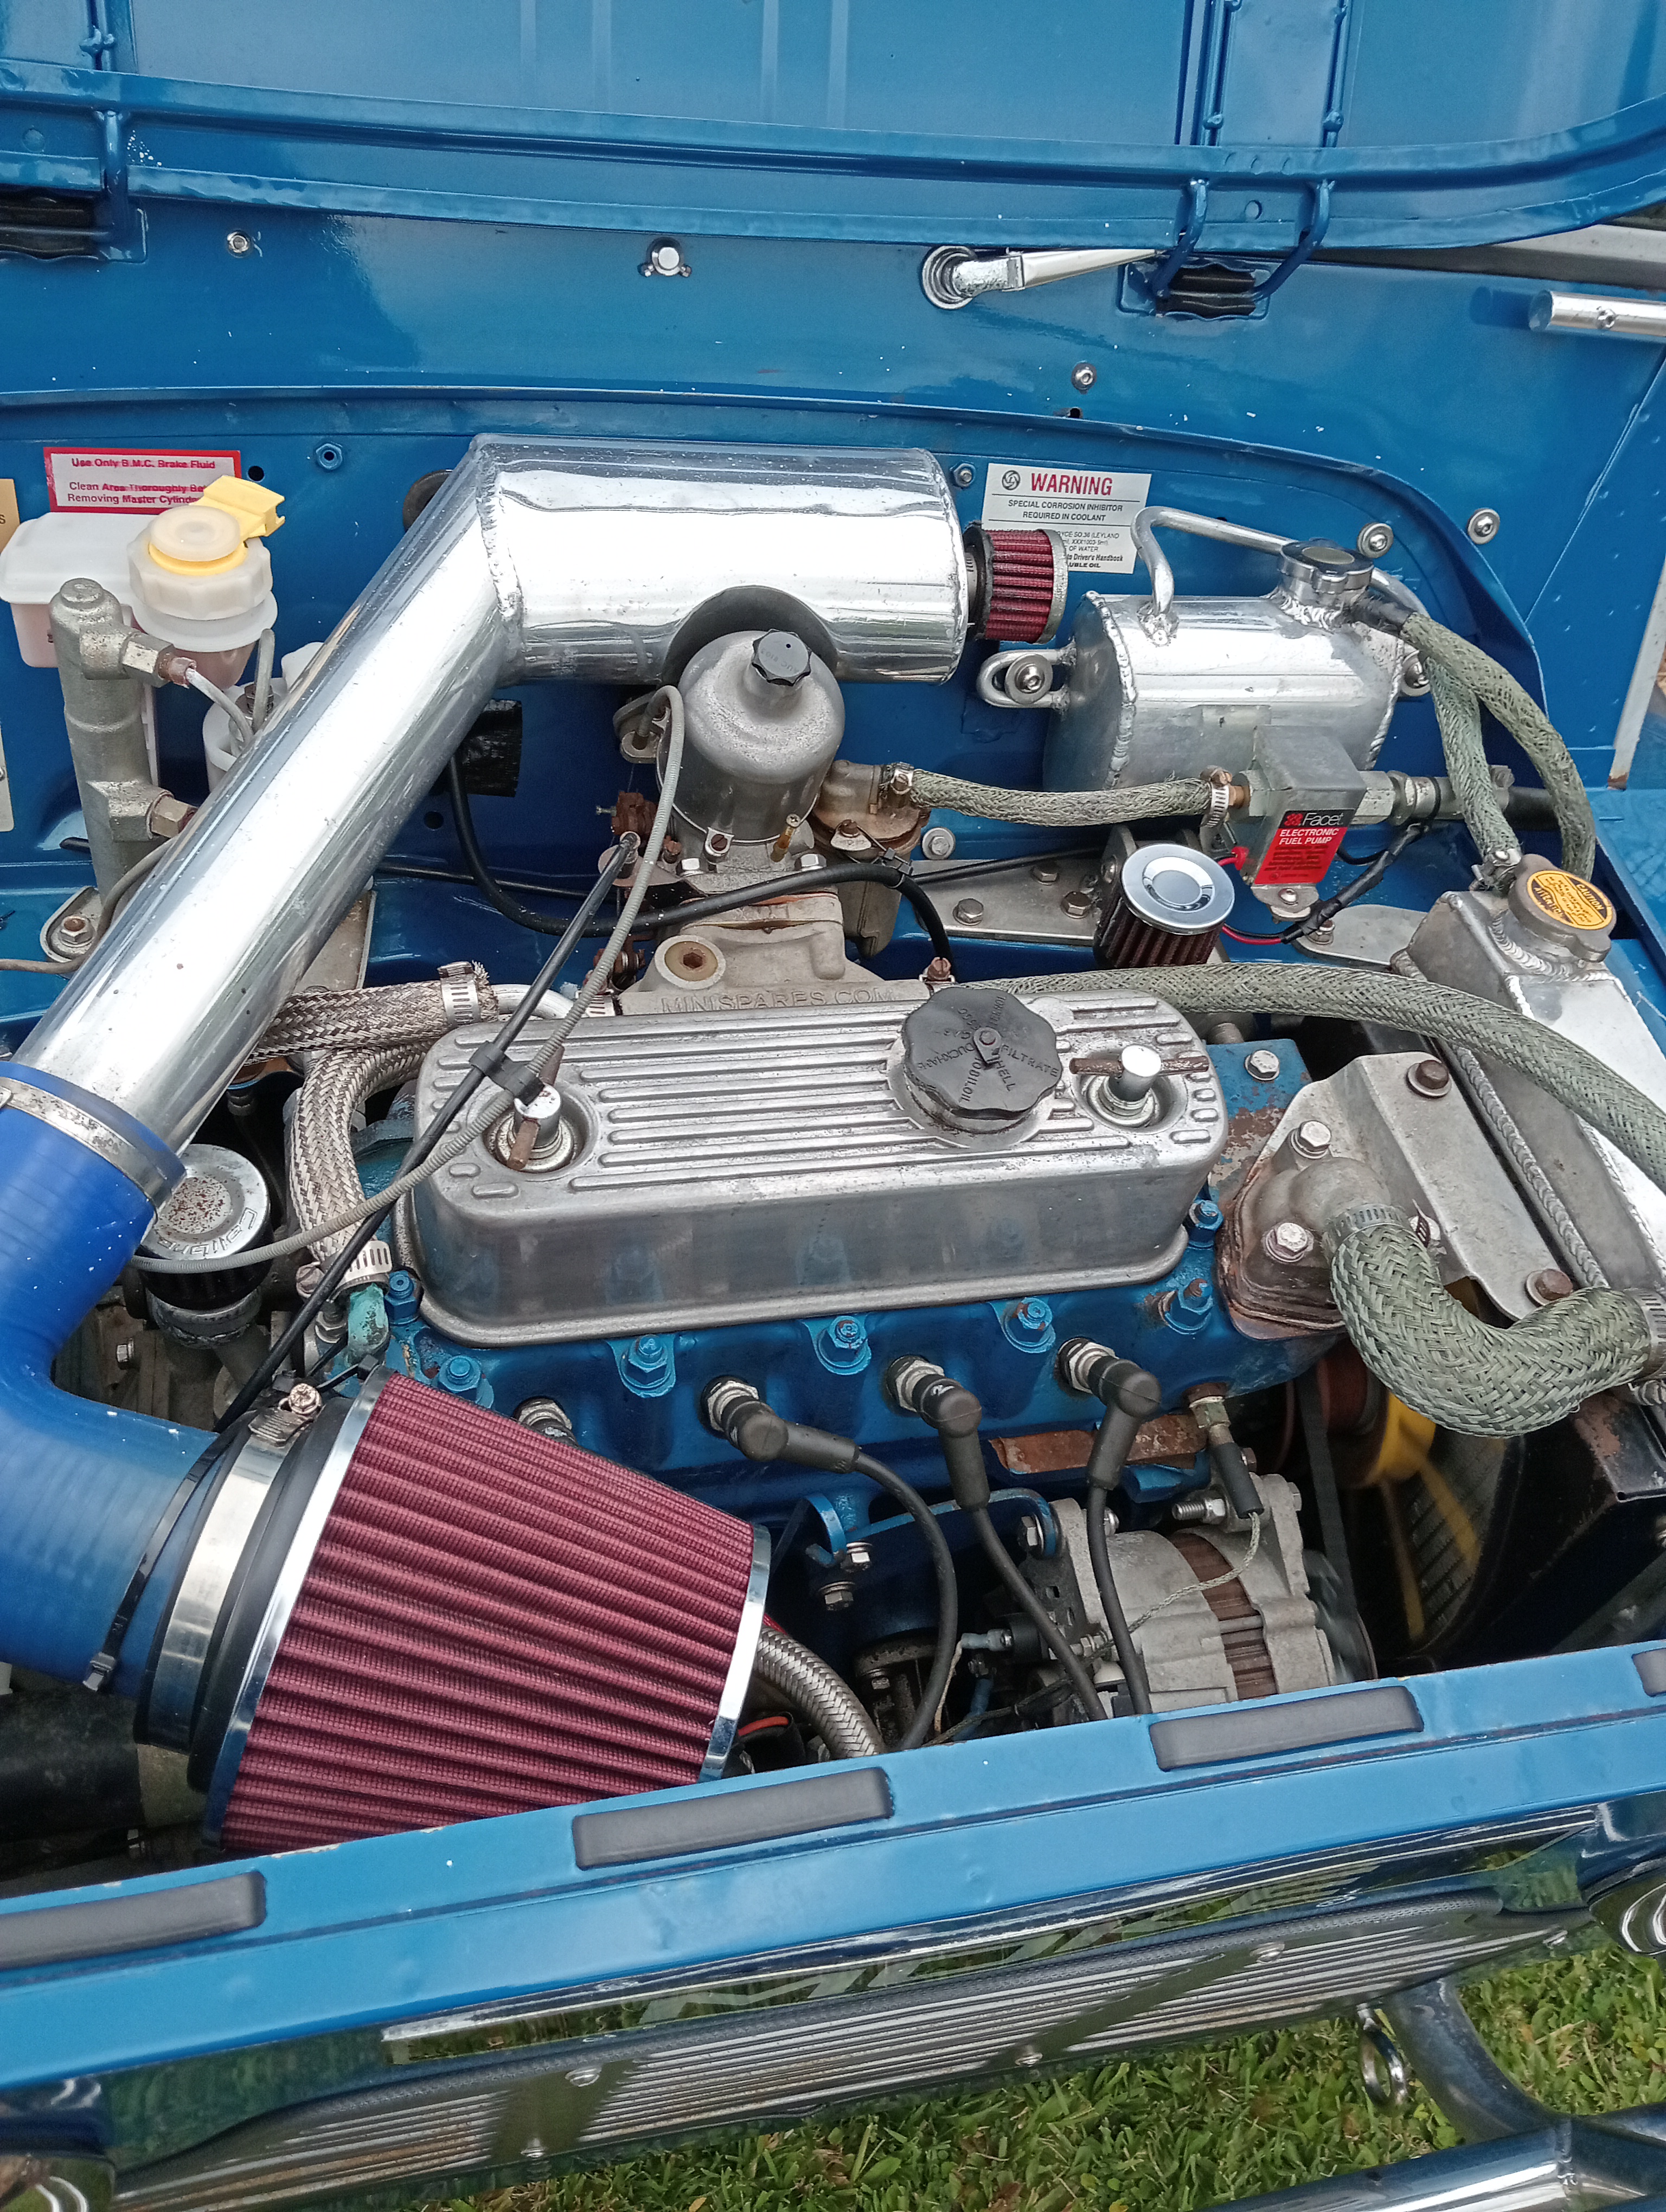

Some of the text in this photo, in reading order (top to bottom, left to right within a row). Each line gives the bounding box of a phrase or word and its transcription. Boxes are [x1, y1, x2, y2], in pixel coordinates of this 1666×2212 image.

[72, 458, 91, 467] Use
[94, 459, 118, 468] Only
[158, 460, 188, 468] Brake
[190, 460, 215, 468] Fluid
[69, 482, 99, 491] Clean
[102, 483, 126, 491] Area
[1031, 473, 1112, 496] WARNING
[68, 493, 200, 505] Removing Master Cylinde
[1008, 499, 1040, 507] SPECIAL
[1042, 501, 1086, 510] CORROSION
[1023, 511, 1060, 519] REQUIRED
[1302, 812, 1343, 826] Facet
[1279, 828, 1340, 837] ELECTRONIC
[1304, 837, 1332, 845] PUMP
[1576, 884, 1605, 911] CAUTION
[1001, 1045, 1059, 1078] FILTRATE
